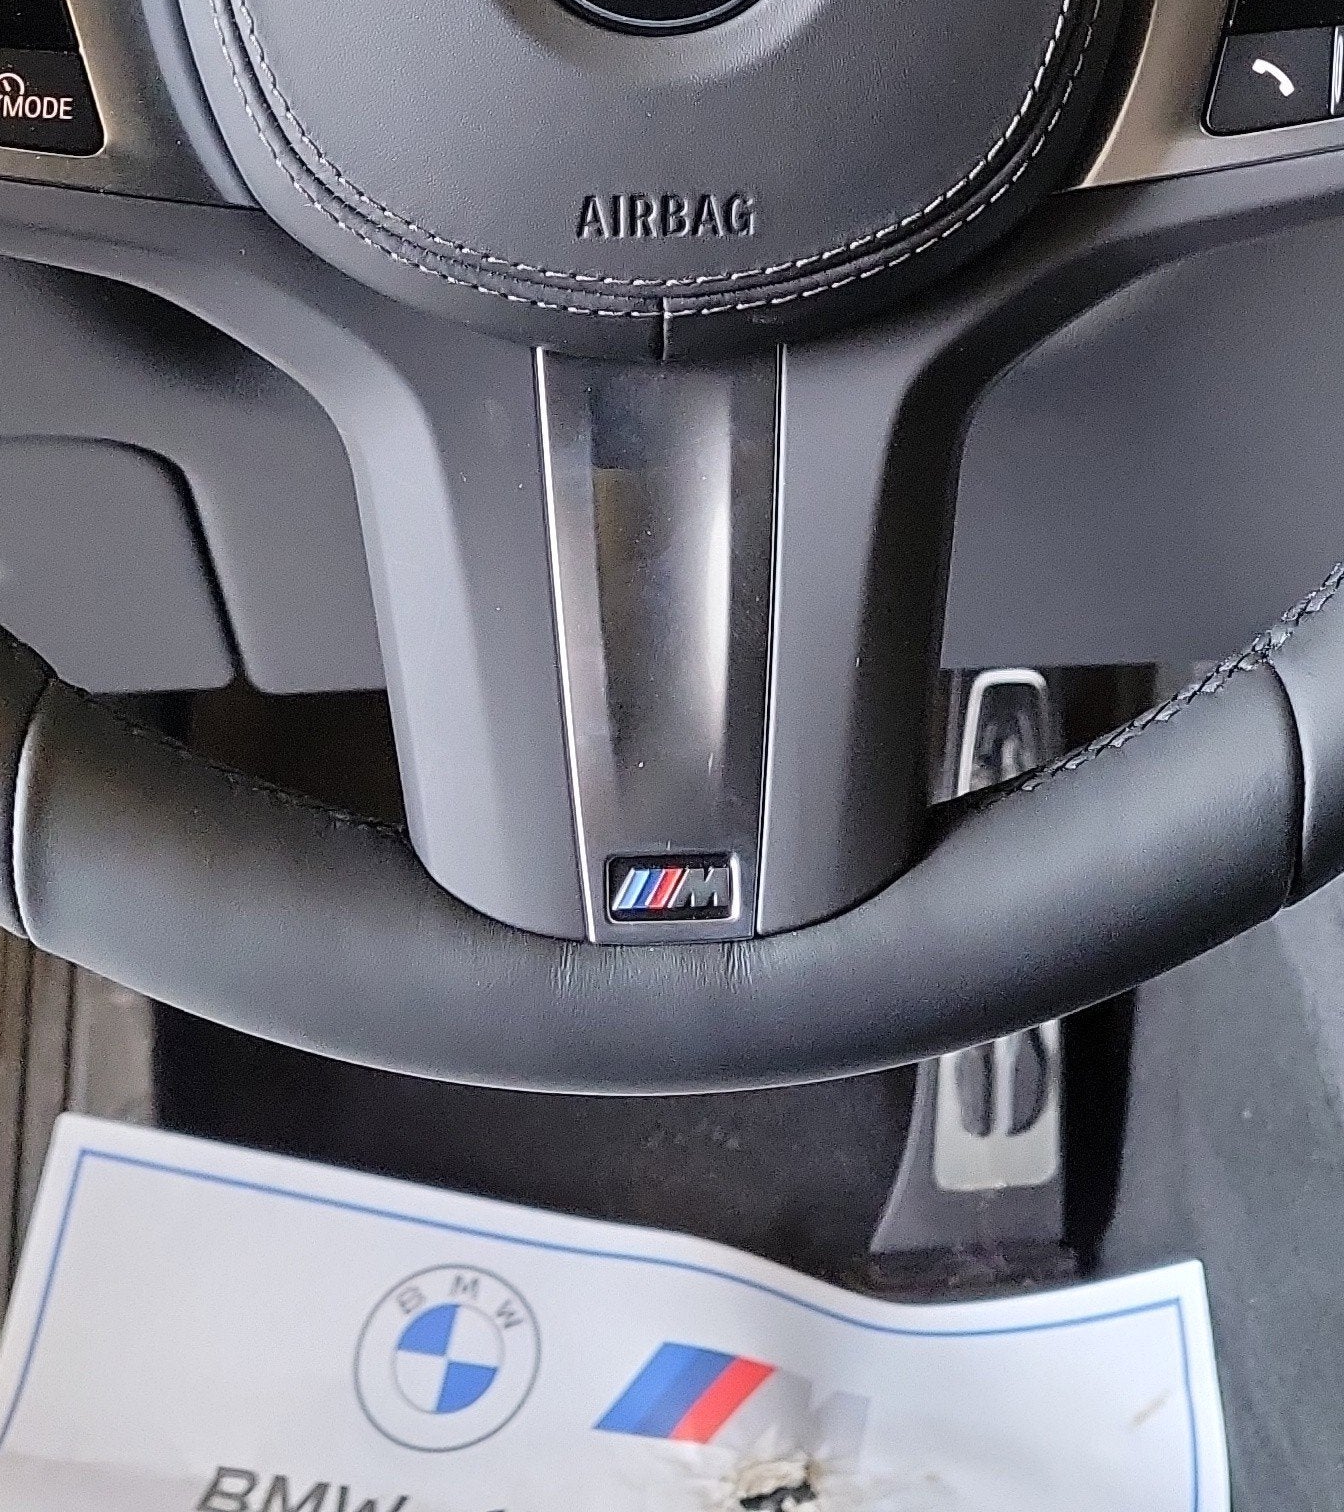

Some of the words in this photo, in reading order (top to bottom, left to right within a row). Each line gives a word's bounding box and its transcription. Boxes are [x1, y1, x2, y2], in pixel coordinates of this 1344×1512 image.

[2, 95, 74, 121] MODE
[574, 192, 757, 240] AIRBAG
[397, 1274, 525, 1331] BMW
